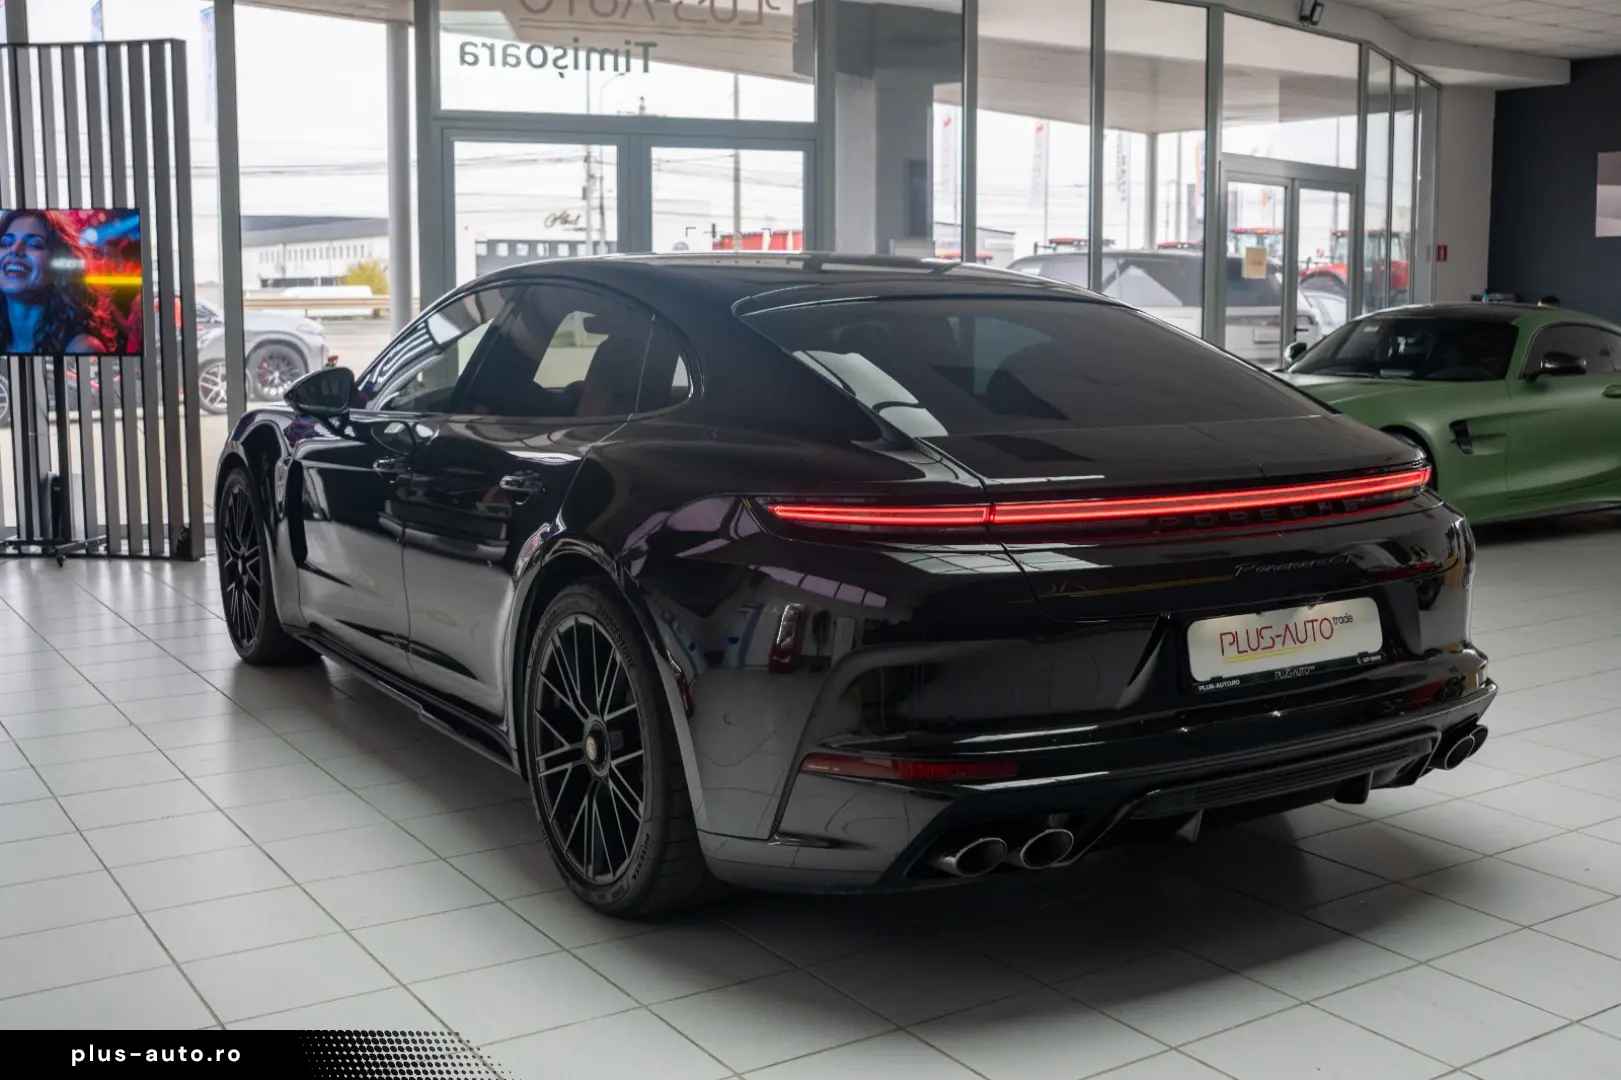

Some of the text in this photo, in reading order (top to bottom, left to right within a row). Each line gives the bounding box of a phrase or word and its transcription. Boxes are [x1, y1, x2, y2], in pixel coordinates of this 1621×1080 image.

[1159, 499, 1360, 530] PORSCHE
[1234, 557, 1329, 577] Panamera
[1219, 613, 1354, 657] PLUS-AUTO trade
